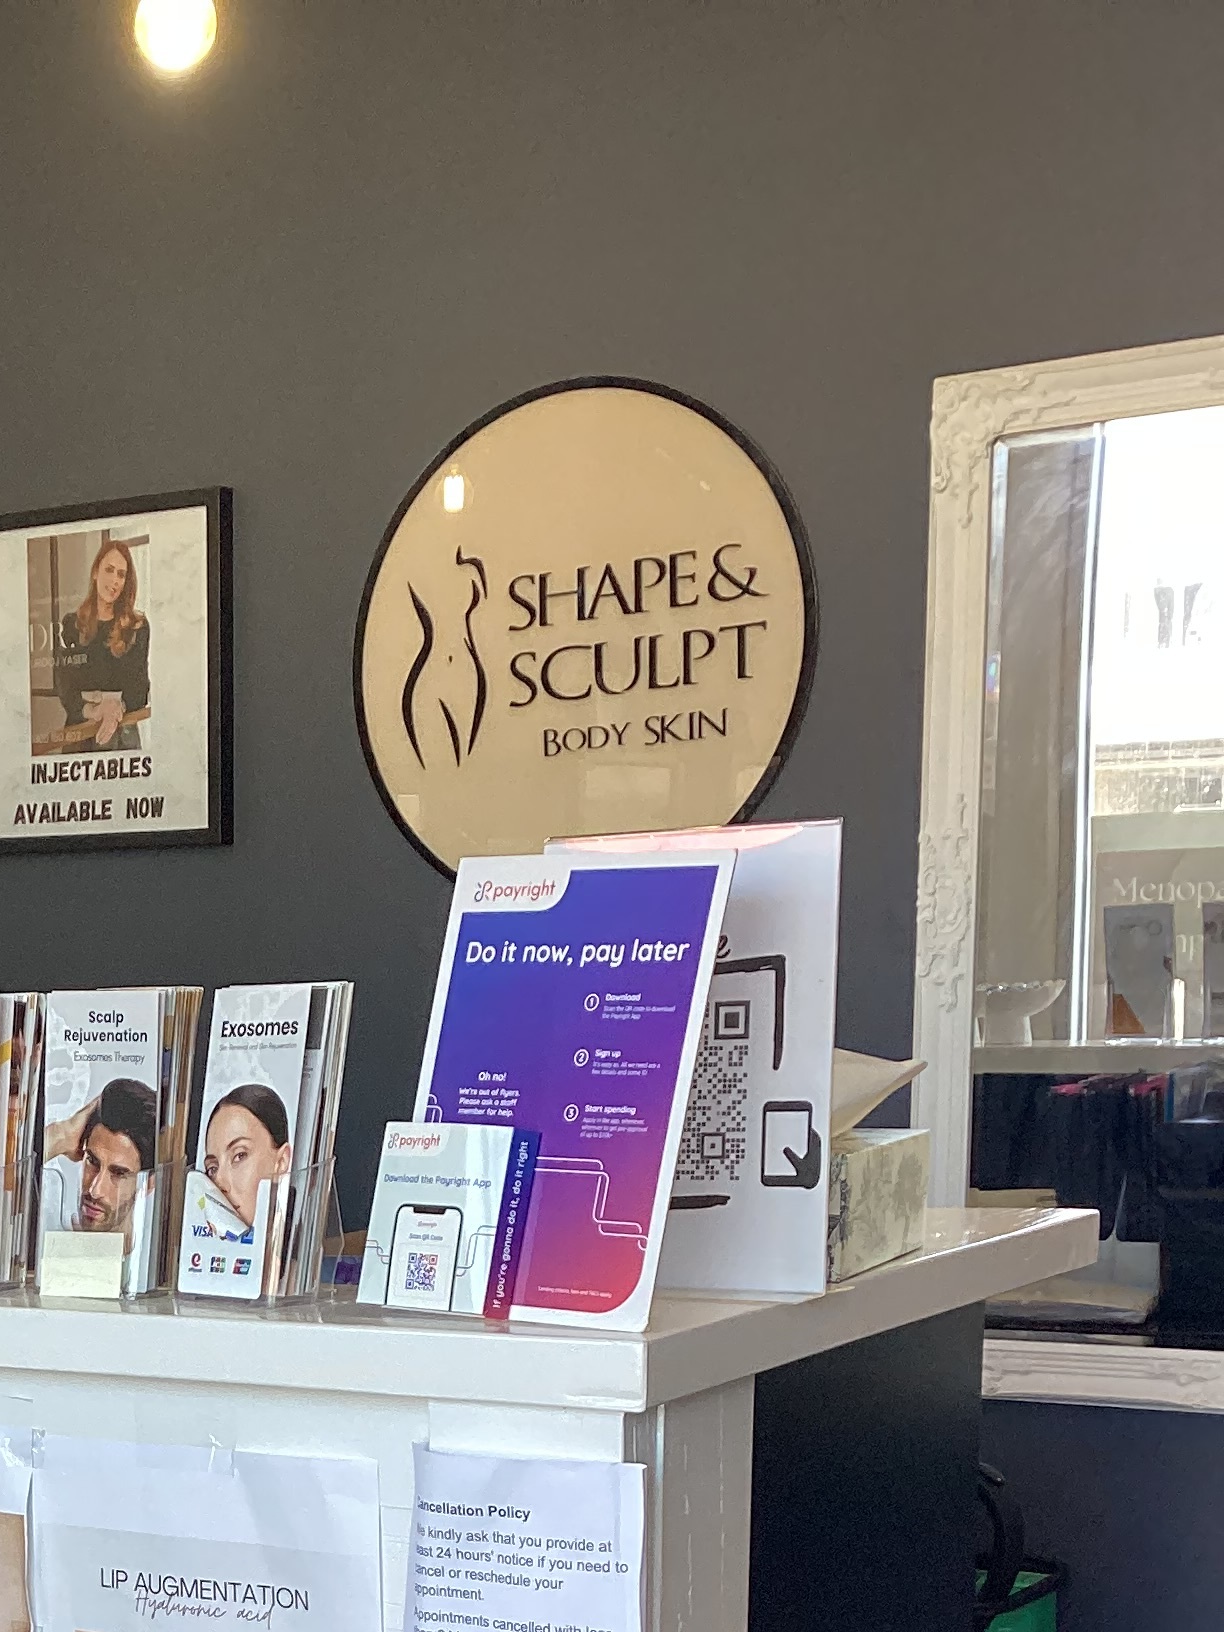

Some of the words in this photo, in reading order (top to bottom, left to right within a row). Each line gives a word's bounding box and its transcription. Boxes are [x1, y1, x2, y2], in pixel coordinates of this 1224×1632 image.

[509, 621, 767, 707] SCULPT
[543, 721, 631, 757] BODY
[644, 708, 728, 746] SKIN
[31, 756, 152, 784] INJECTABLES
[14, 800, 112, 825] AVAILABLE
[126, 797, 165, 818] NOW
[493, 879, 556, 902] payright
[465, 941, 497, 963] Do
[501, 939, 517, 963] it
[523, 942, 574, 967] now,
[580, 945, 624, 967] pay
[631, 939, 689, 962] later
[605, 993, 641, 1001] Download
[89, 1010, 124, 1027] Scalp
[64, 1028, 147, 1045] Rejuvenation
[221, 1020, 298, 1037] Exosomes
[74, 1051, 112, 1061] Exosomes
[114, 1051, 145, 1065] Therapy
[595, 1049, 610, 1058] Sign
[478, 1072, 491, 1081] Oh
[492, 1072, 507, 1081] no!
[604, 1105, 636, 1115] spending
[399, 1134, 440, 1149] payright
[517, 1142, 528, 1167] right
[384, 1174, 419, 1184] Download
[421, 1175, 433, 1184] the
[435, 1176, 471, 1187] Payright
[473, 1178, 492, 1188] App
[516, 1169, 523, 1178] it
[512, 1180, 521, 1193] do
[509, 1211, 516, 1224] do
[192, 1225, 213, 1237] VISA
[503, 1228, 513, 1262] gonna
[496, 1265, 507, 1298] you're
[417, 1497, 484, 1517] ancellation
[488, 1505, 531, 1522] Policy
[428, 1526, 462, 1543] kindly
[466, 1530, 489, 1543] ask
[492, 1531, 515, 1546] that
[519, 1536, 542, 1548] you
[546, 1537, 594, 1552] provide
[599, 1540, 612, 1553] at
[100, 1567, 129, 1590] LIP
[134, 1572, 309, 1611] AUGMENTATION
[135, 1591, 227, 1619] Hyaluronic
[236, 1598, 274, 1630] acid
